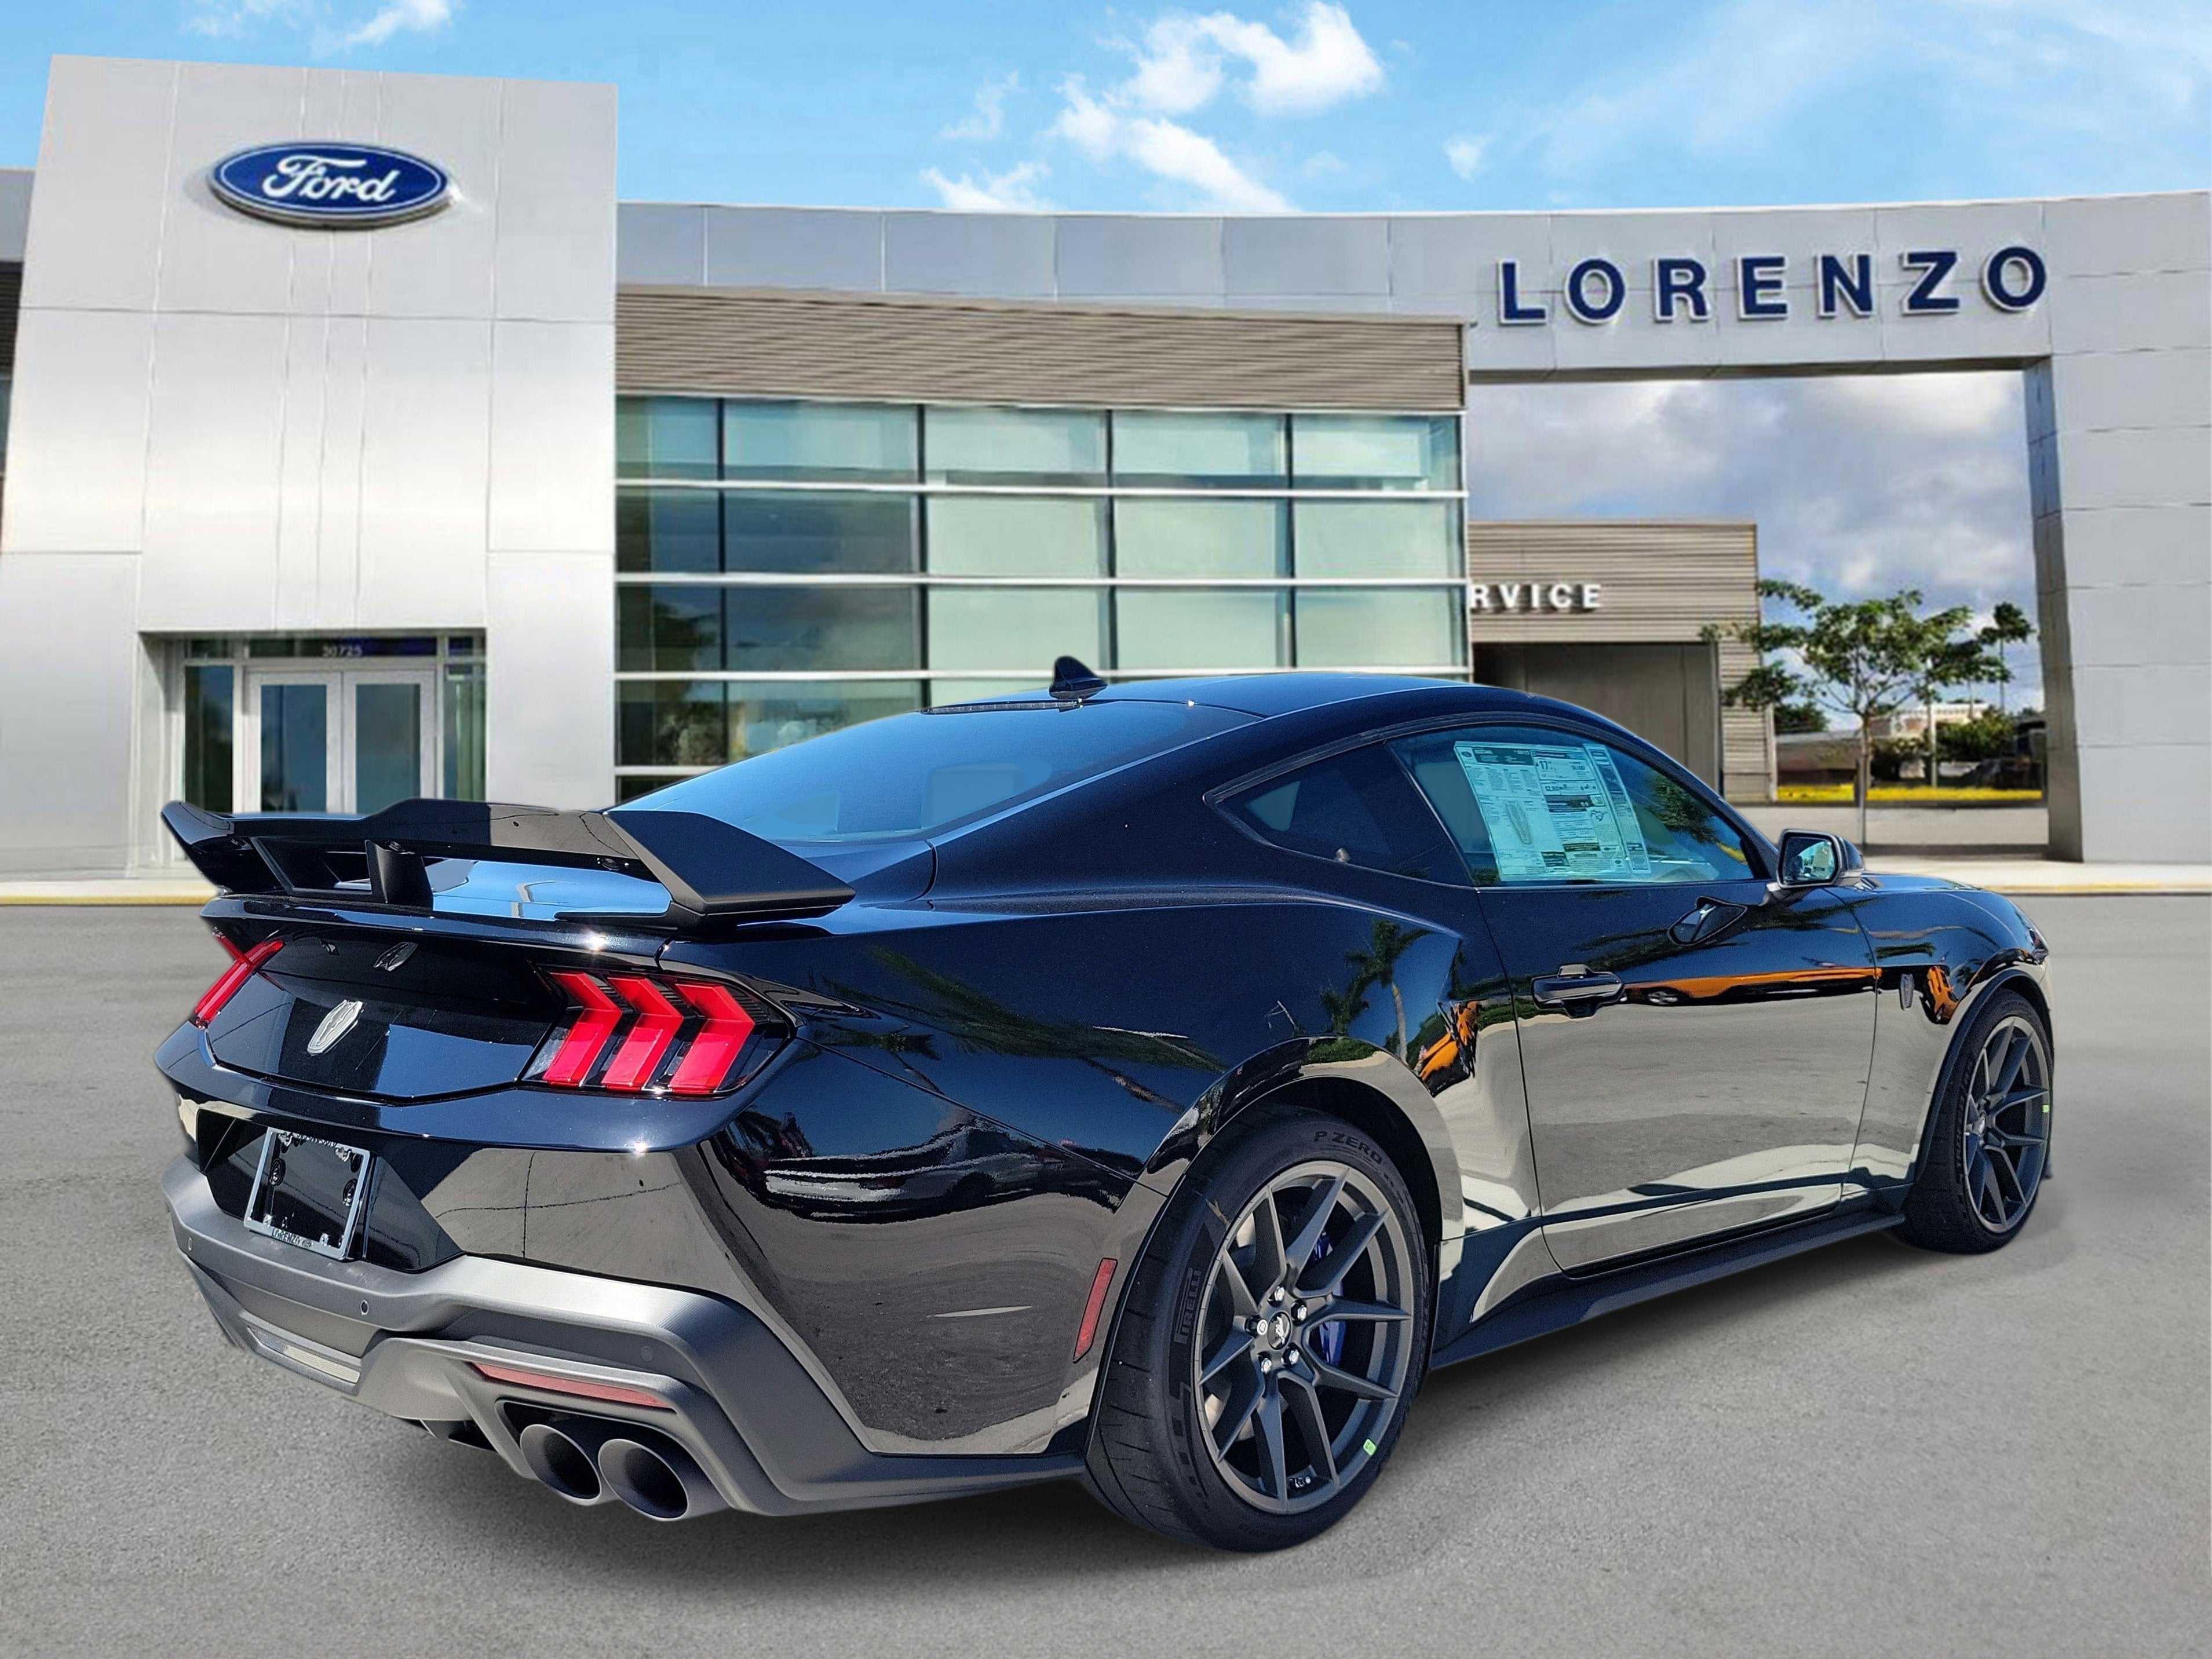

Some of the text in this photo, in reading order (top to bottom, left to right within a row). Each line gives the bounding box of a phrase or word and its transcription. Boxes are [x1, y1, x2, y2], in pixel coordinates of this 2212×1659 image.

[262, 154, 400, 202] Ford
[1496, 245, 2047, 325] LORENZO
[1313, 1130, 1383, 1164] P ZERO
[271, 1227, 301, 1245] LORENZO
[1174, 1267, 1202, 1344] PIRELLI
